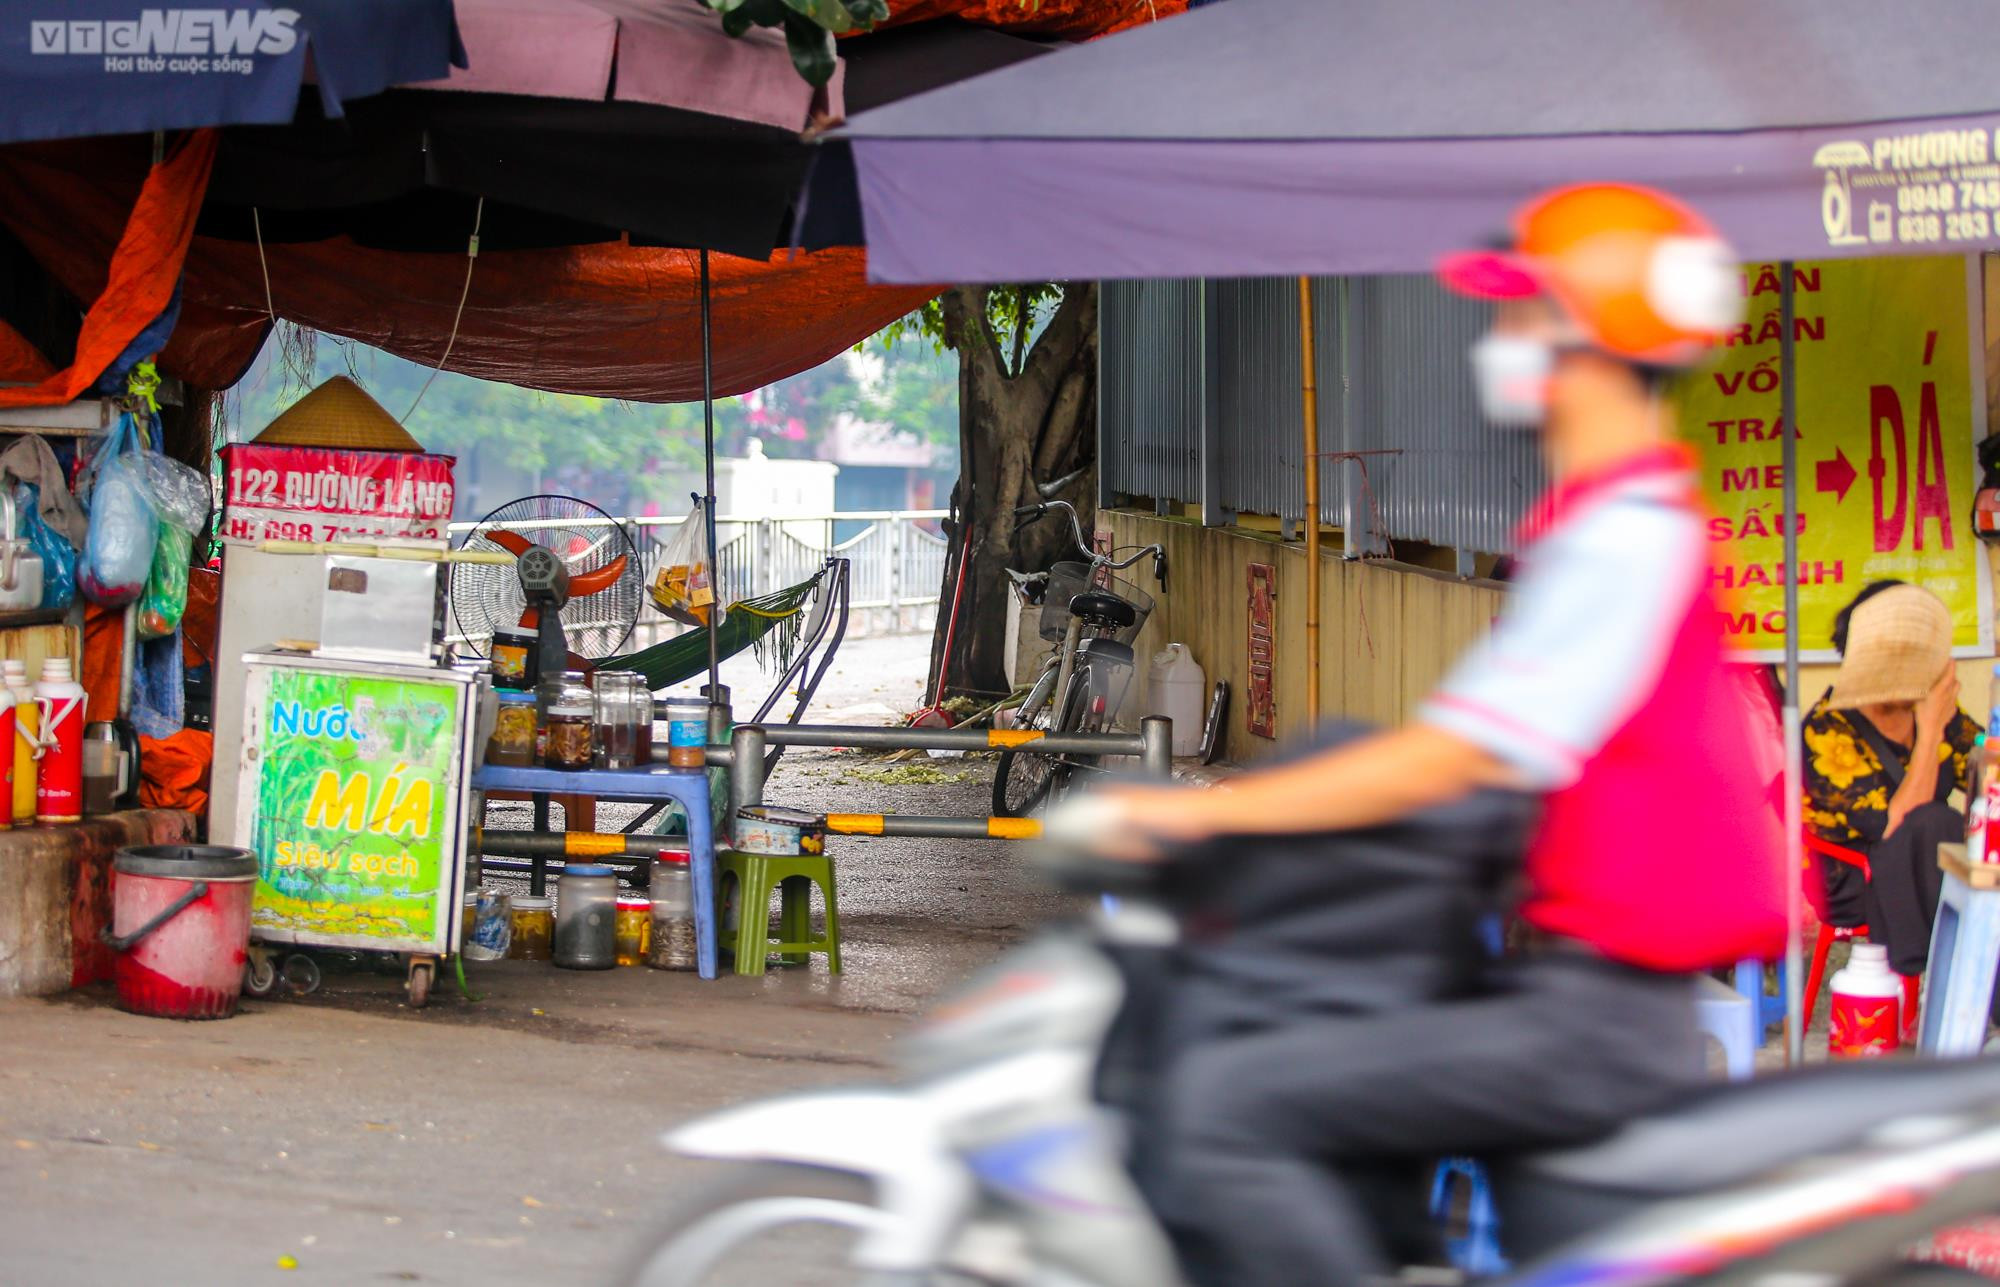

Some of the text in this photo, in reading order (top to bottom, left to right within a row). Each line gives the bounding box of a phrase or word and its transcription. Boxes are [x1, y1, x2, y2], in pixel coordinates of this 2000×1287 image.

[1738, 264, 1820, 297] ÂN
[1868, 331, 1954, 553] ĐÁ
[231, 466, 452, 516] 122 ĐƯỜNG LÁNG
[1705, 560, 1843, 589] HANH
[304, 761, 432, 837] MÍA
[276, 841, 418, 880] Siêu sạch
